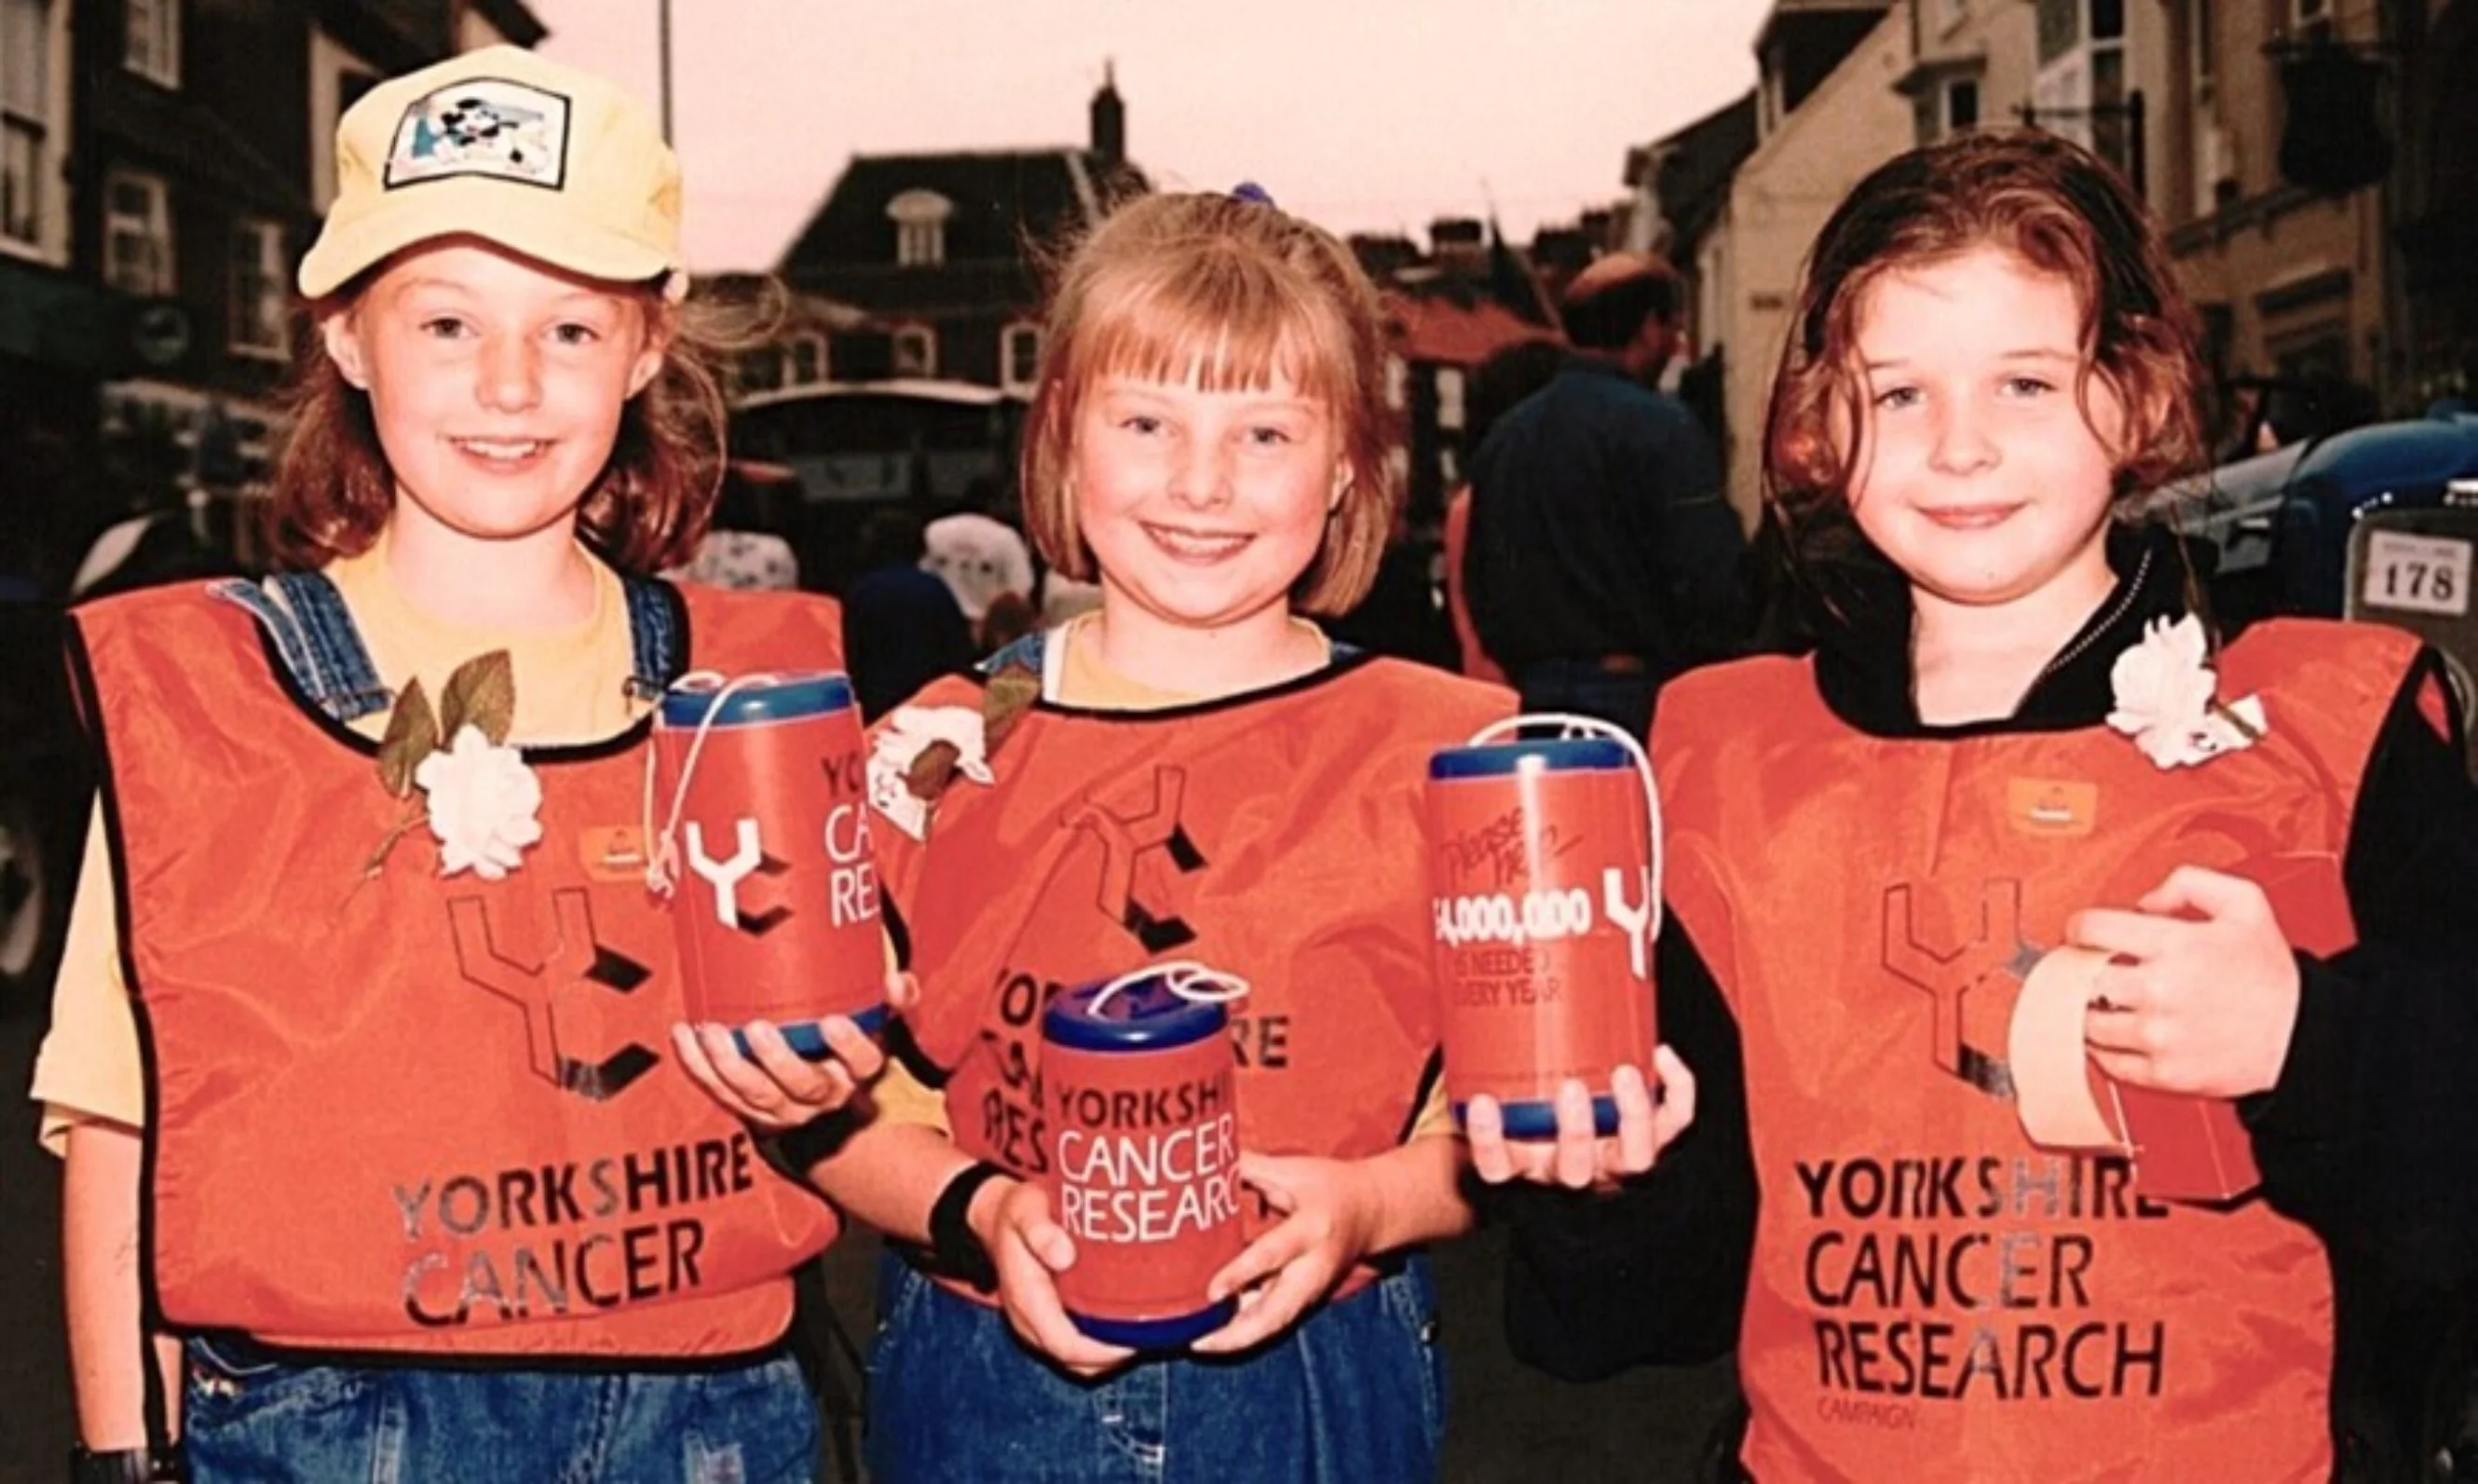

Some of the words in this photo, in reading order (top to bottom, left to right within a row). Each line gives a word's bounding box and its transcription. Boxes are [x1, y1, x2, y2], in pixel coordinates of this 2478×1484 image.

[2386, 561, 2454, 601] 178
[393, 1131, 754, 1241] YORKSHIRE
[1057, 1112, 1235, 1187] CANCER
[404, 1219, 704, 1327] CANCER
[1804, 1231, 2094, 1309] CANCER
[1813, 1319, 2166, 1401] RESEARCH
